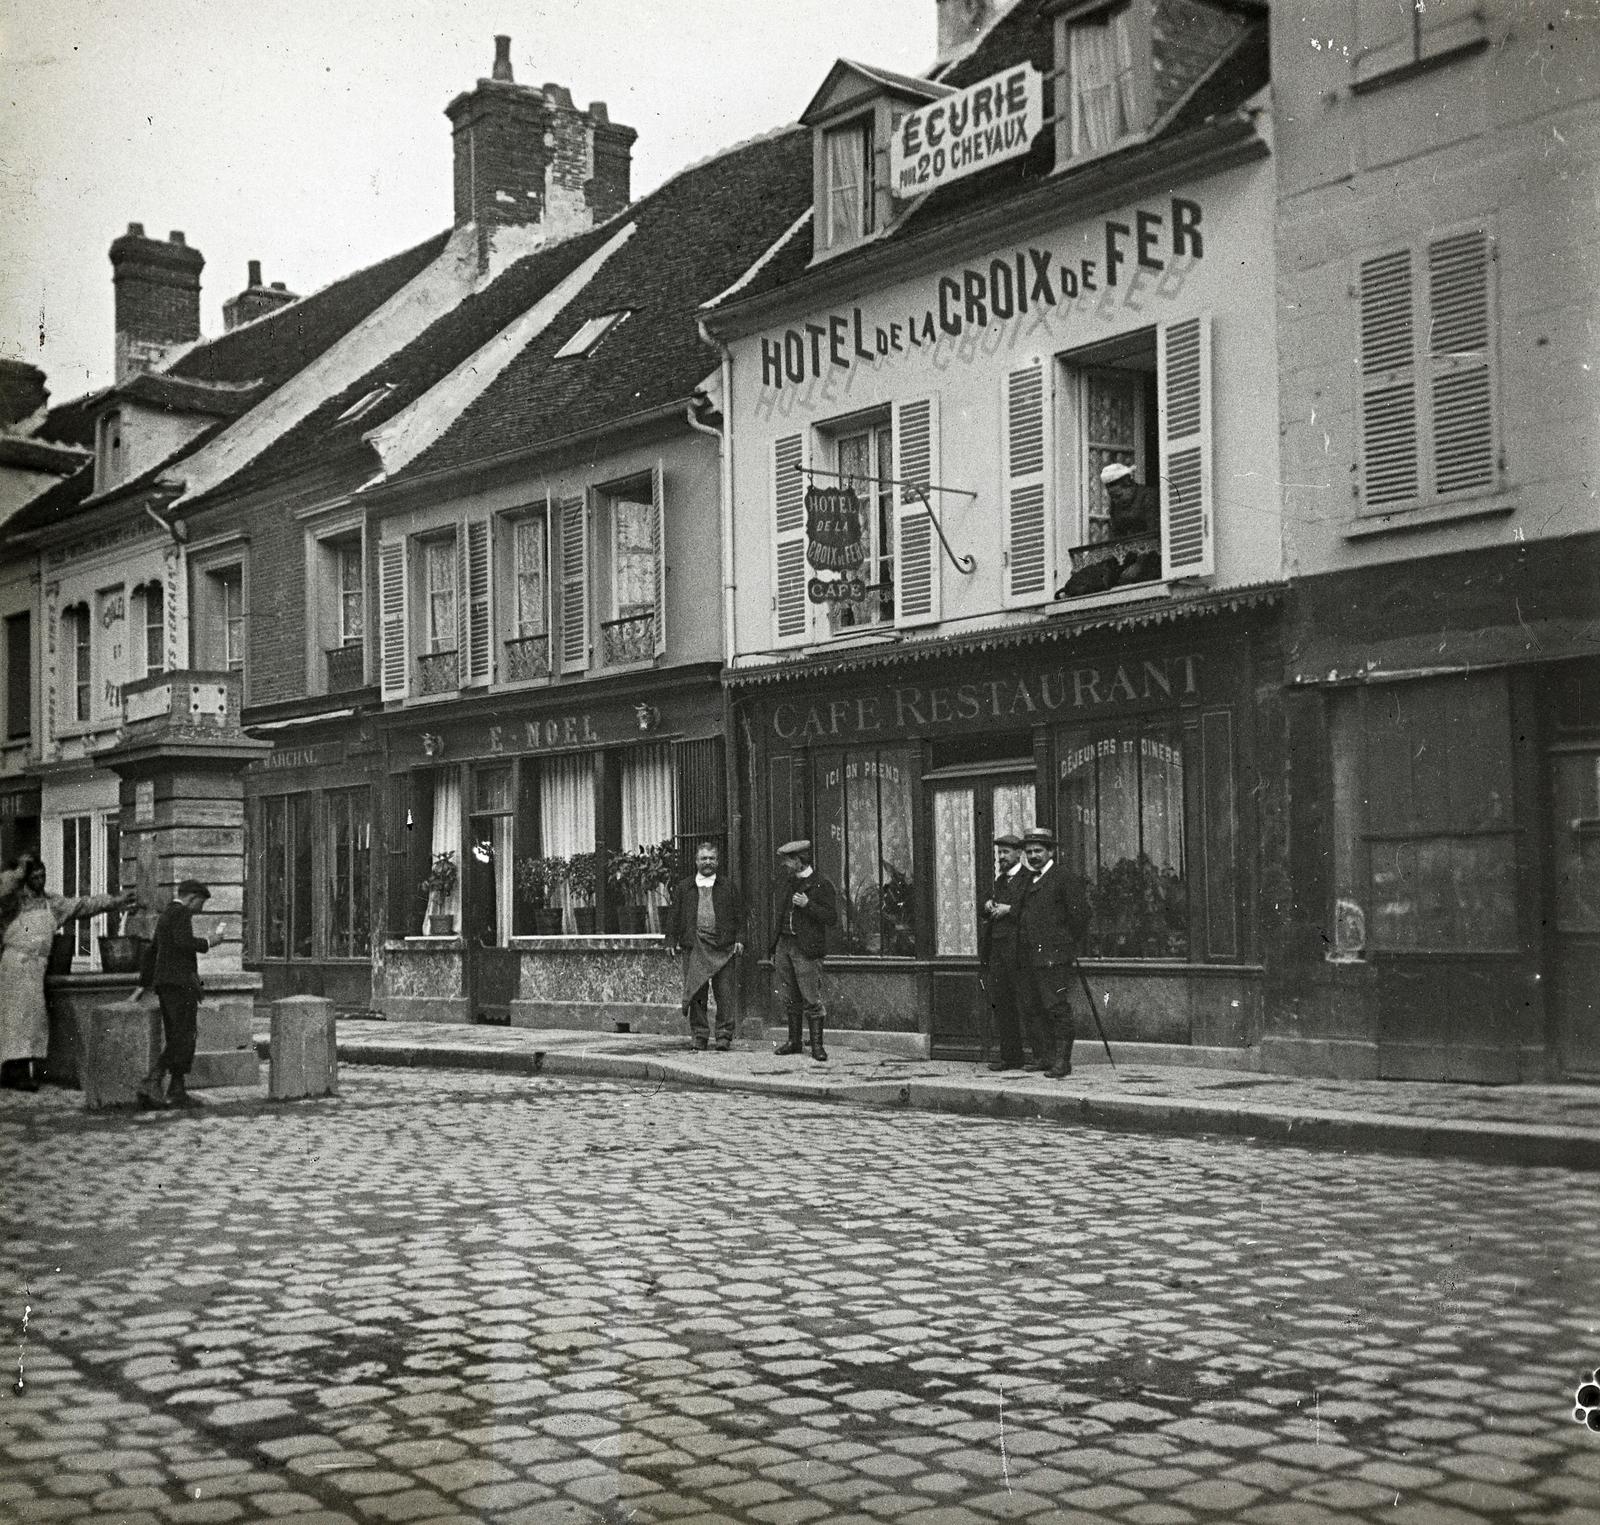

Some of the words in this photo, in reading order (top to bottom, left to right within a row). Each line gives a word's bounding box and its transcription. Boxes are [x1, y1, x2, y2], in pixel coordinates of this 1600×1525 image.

[917, 148, 946, 184] 20
[950, 112, 1028, 170] CHEVAUX
[761, 307, 875, 389] HOTEL
[875, 322, 904, 356] DE
[908, 310, 937, 347] LA
[938, 248, 1056, 337] CROIX
[1060, 260, 1098, 299] DE
[1105, 197, 1204, 287] FER
[808, 495, 857, 514] HOTEL
[816, 520, 831, 532] DE
[835, 521, 849, 532] LA
[807, 540, 838, 566] CROIX
[844, 542, 863, 564] FER
[811, 583, 862, 597] CAFE
[773, 700, 881, 738] CAFE
[895, 656, 1204, 726] RESTAURANT
[524, 714, 598, 748] NOEL
[864, 761, 899, 783] PREND
